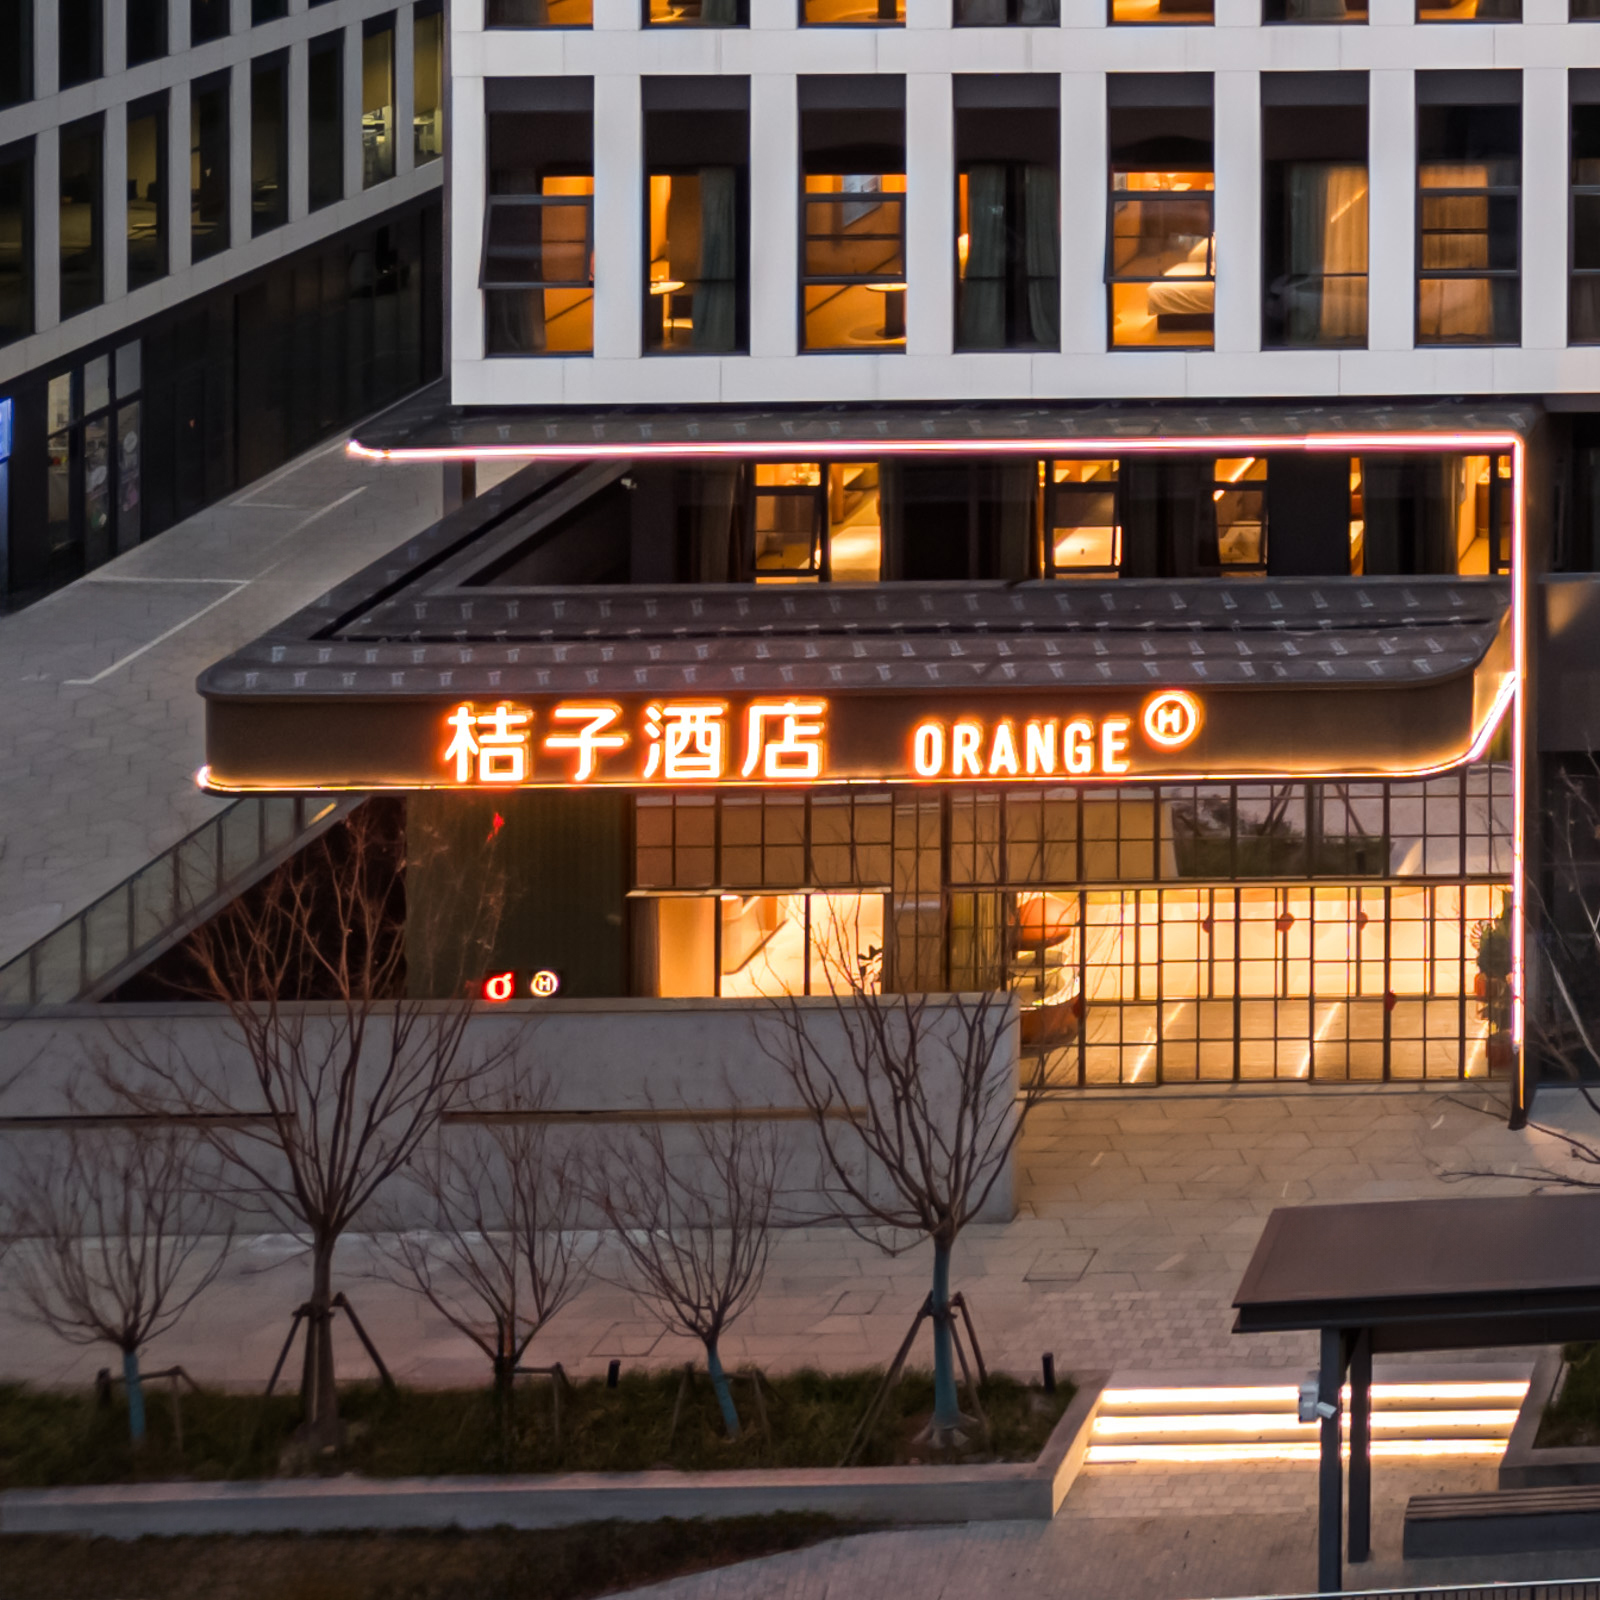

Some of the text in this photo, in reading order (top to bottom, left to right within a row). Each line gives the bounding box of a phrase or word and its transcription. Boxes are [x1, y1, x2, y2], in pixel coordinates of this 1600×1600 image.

[442, 699, 828, 782] 桔子酒店
[912, 718, 1132, 777] ORANGE
